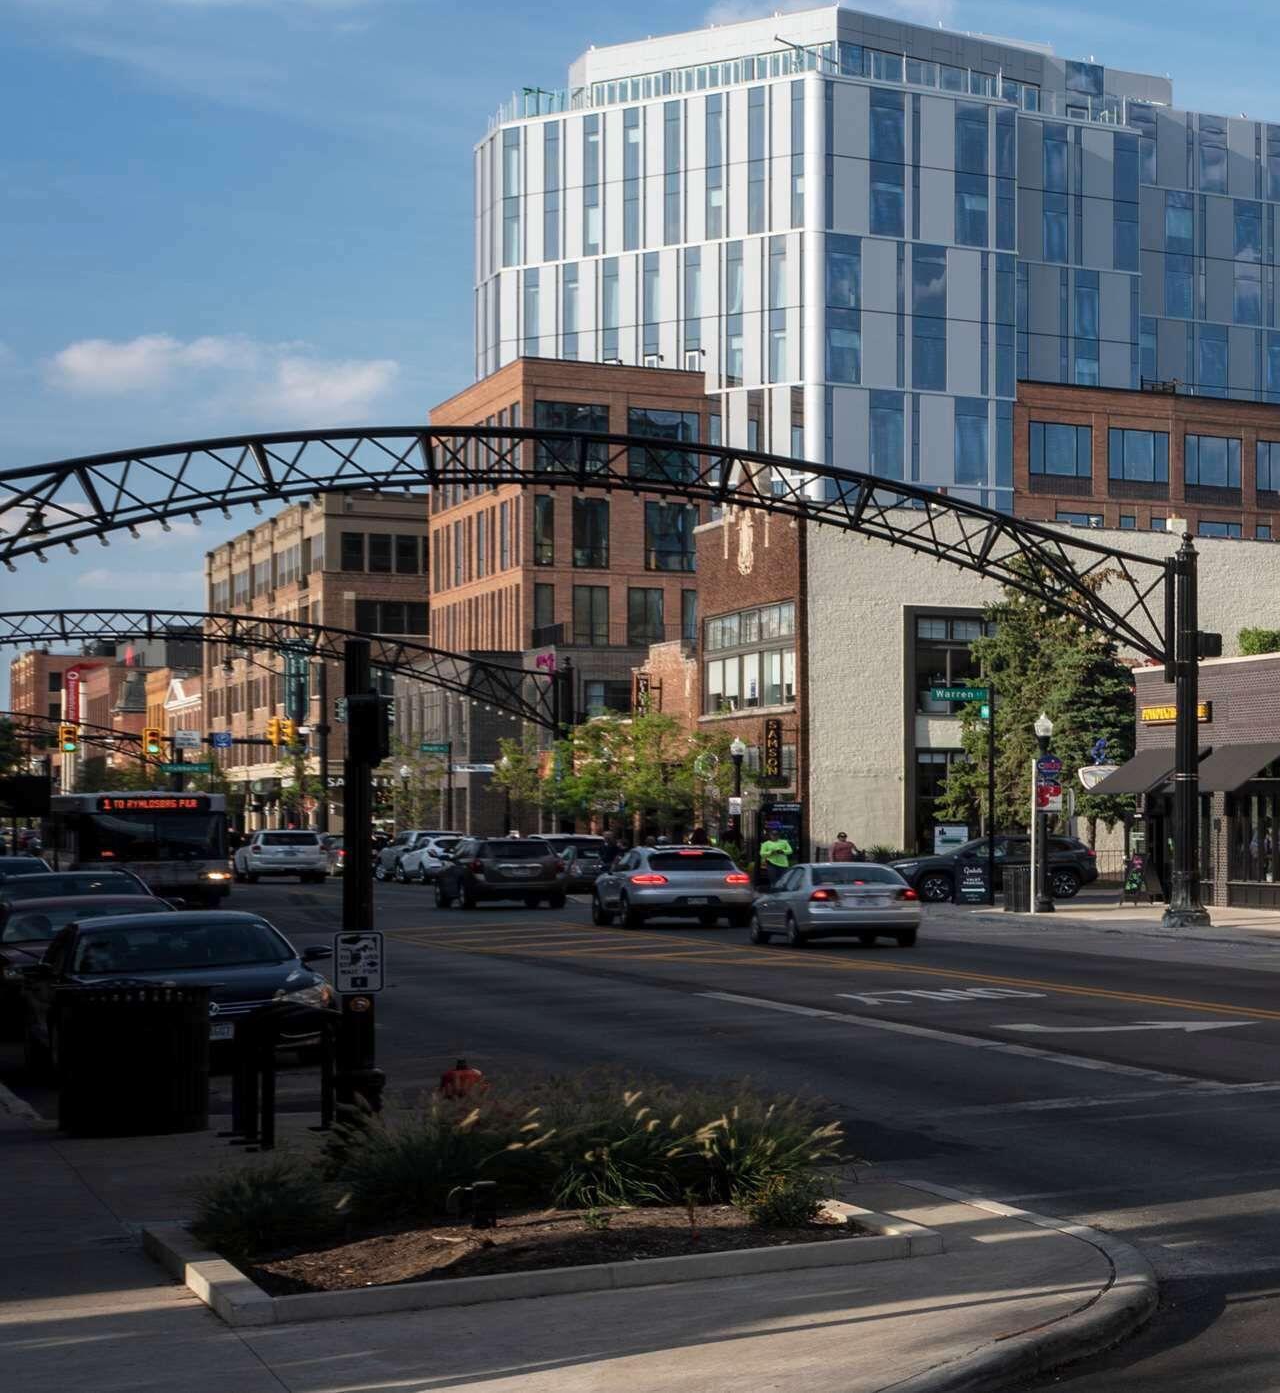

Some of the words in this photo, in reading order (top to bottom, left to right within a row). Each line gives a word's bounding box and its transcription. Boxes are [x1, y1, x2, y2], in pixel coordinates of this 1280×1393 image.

[936, 690, 974, 698] Warren
[767, 720, 779, 776] SAMSON
[104, 799, 111, 809] 1
